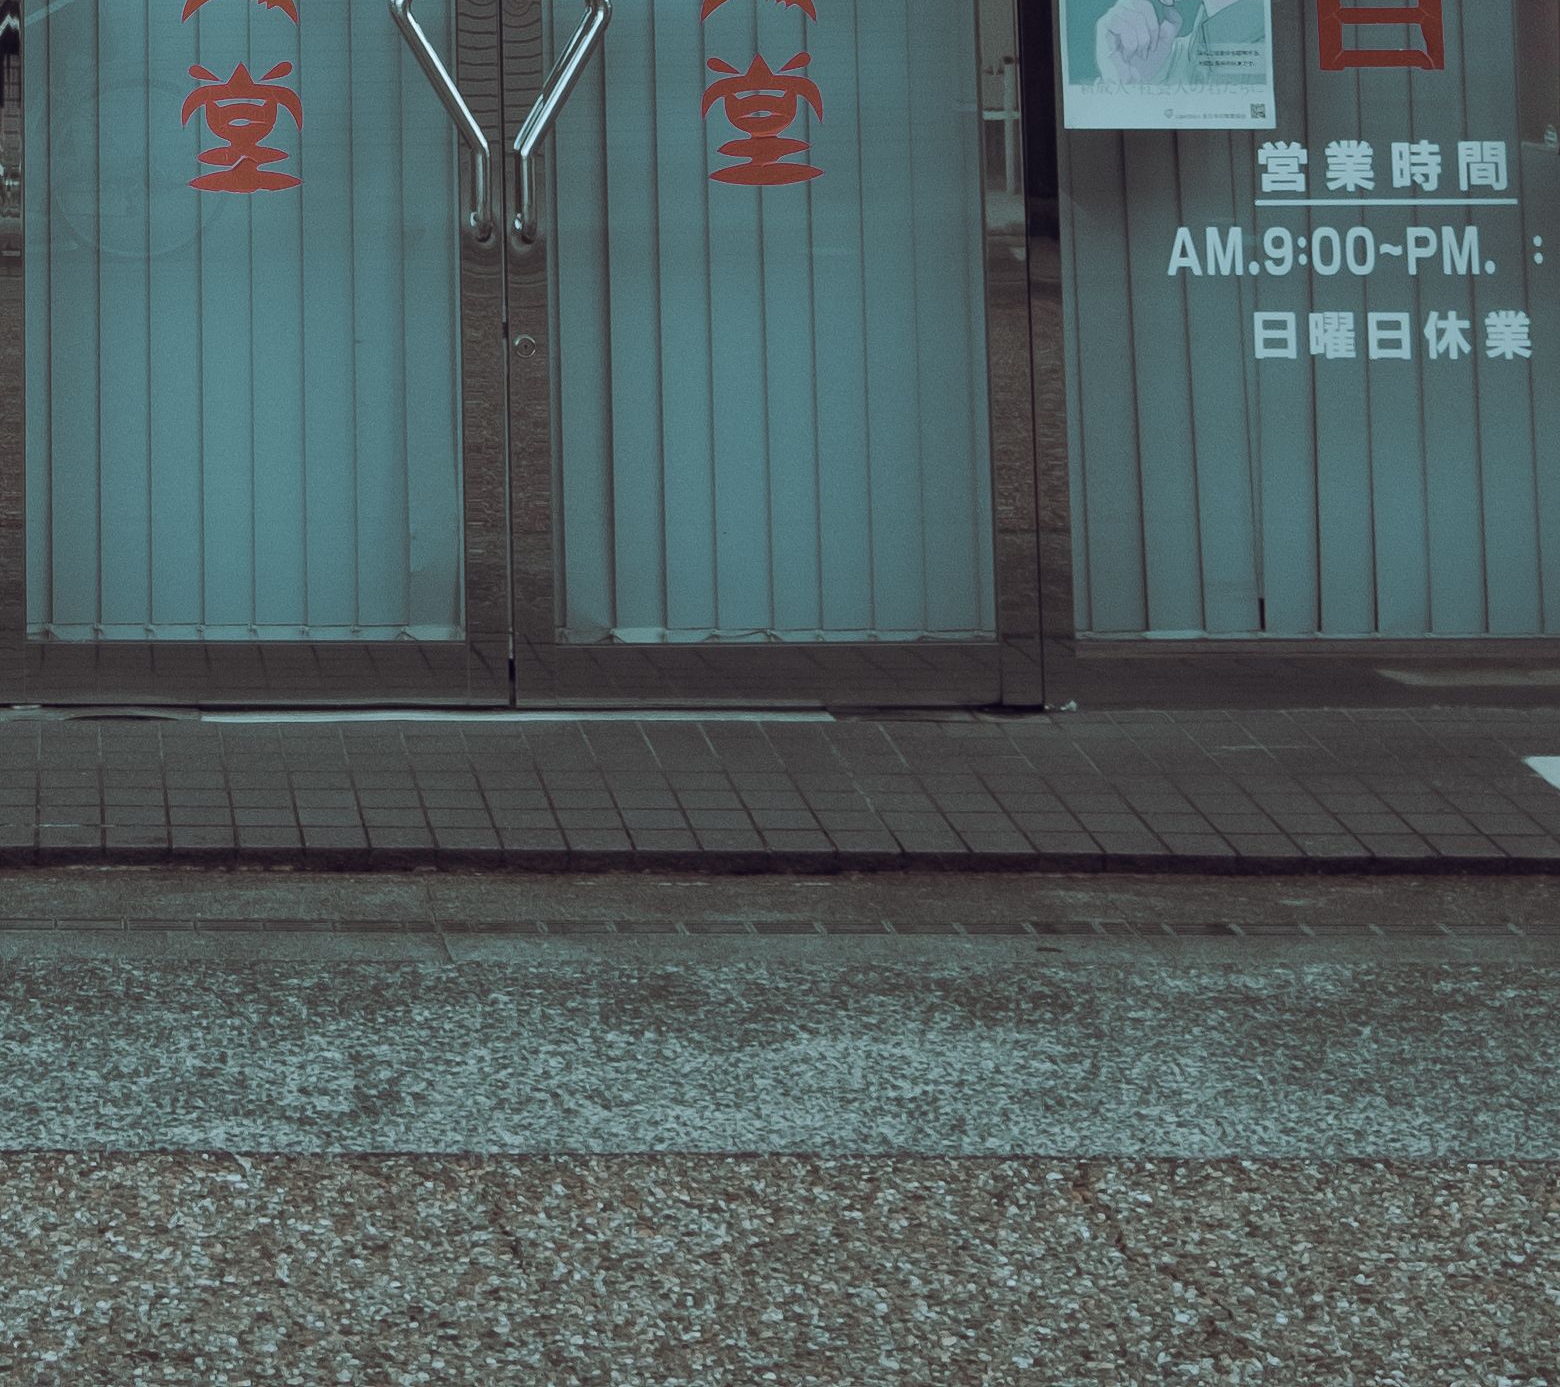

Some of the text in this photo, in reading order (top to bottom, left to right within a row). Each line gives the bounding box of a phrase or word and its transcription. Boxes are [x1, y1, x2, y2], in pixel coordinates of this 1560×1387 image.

[1257, 140, 1508, 191] 営業時間
[1253, 309, 1533, 361] 日曜日休業
